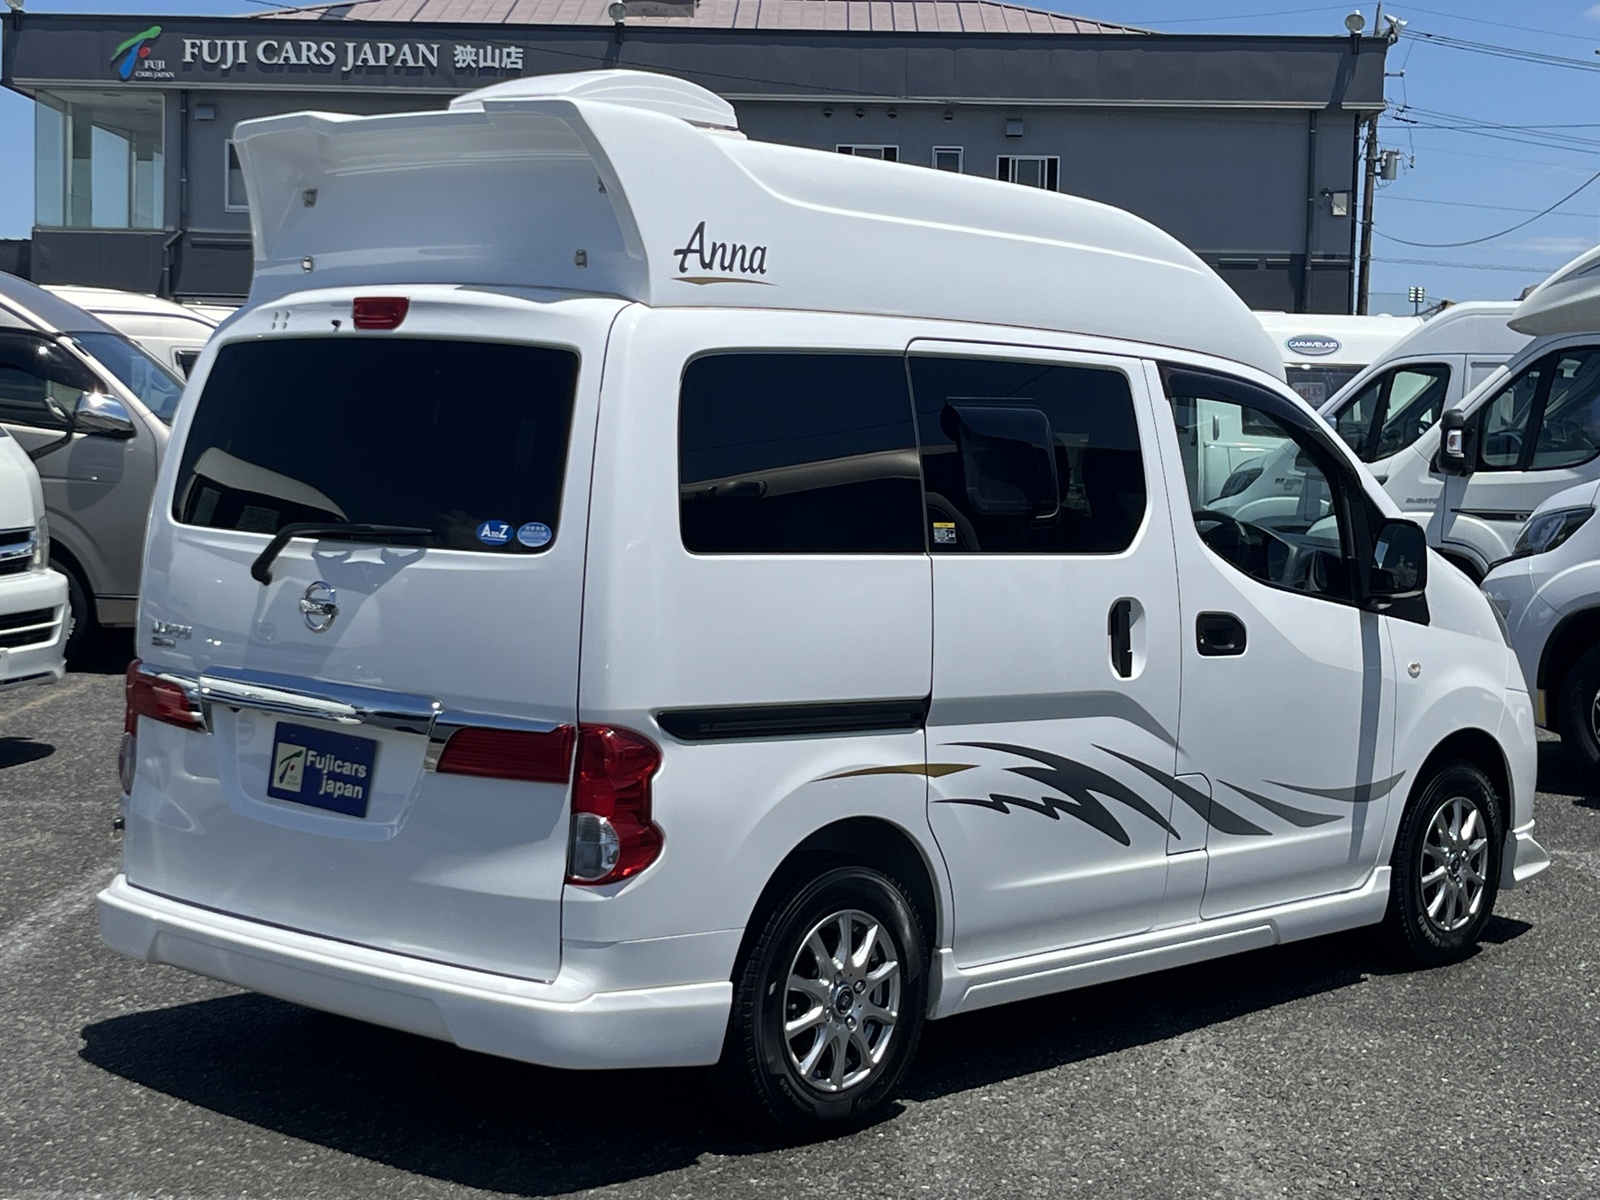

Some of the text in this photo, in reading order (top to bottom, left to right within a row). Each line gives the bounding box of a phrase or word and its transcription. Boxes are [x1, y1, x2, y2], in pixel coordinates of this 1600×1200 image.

[144, 60, 166, 70] FUJI
[182, 38, 440, 71] FUJI CARS JAPAN
[453, 45, 524, 69] 狭山店
[673, 221, 767, 275] Anna
[306, 750, 368, 778] Fujicars
[319, 775, 363, 799] japan
